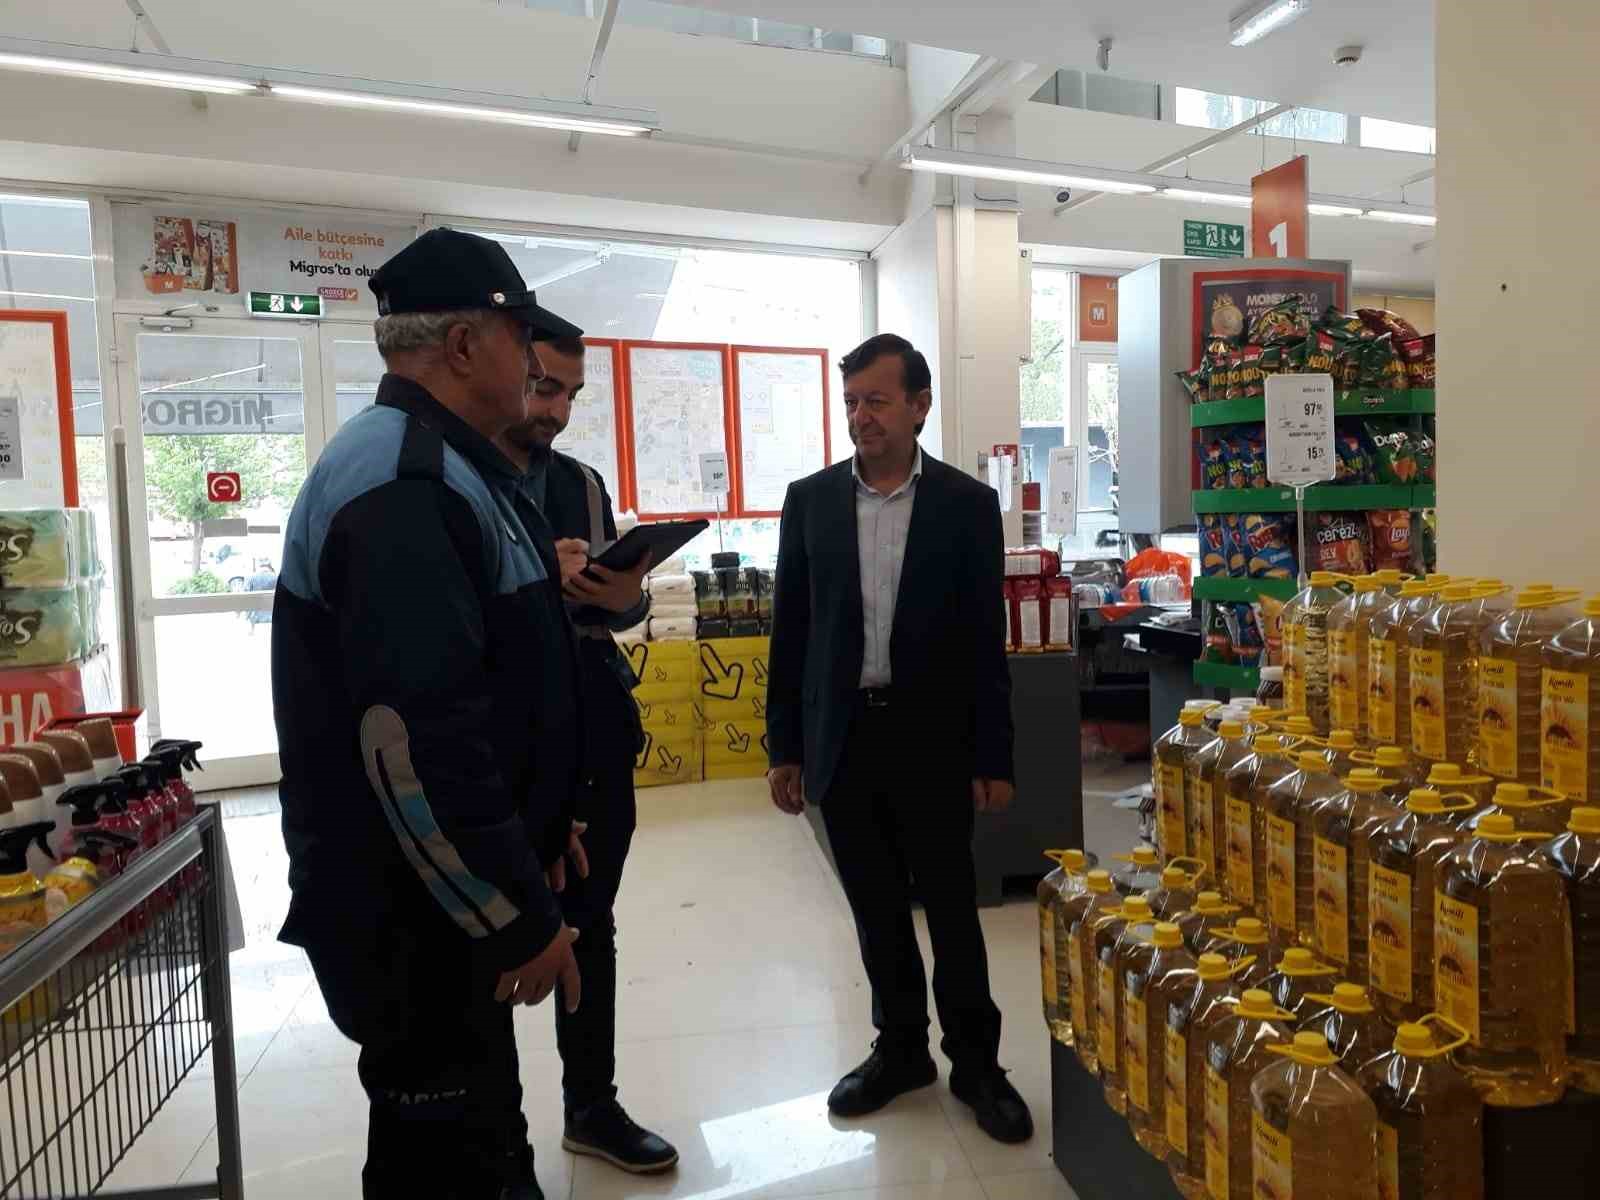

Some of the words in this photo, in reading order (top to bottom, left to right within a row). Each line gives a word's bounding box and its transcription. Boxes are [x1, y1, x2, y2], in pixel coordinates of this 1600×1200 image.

[284, 226, 312, 241] Aile
[317, 229, 384, 247] bütçesine
[1268, 221, 1287, 257] 1
[319, 246, 352, 260] katkı
[289, 260, 350, 277] Migros'ta
[1092, 307, 1104, 321] M
